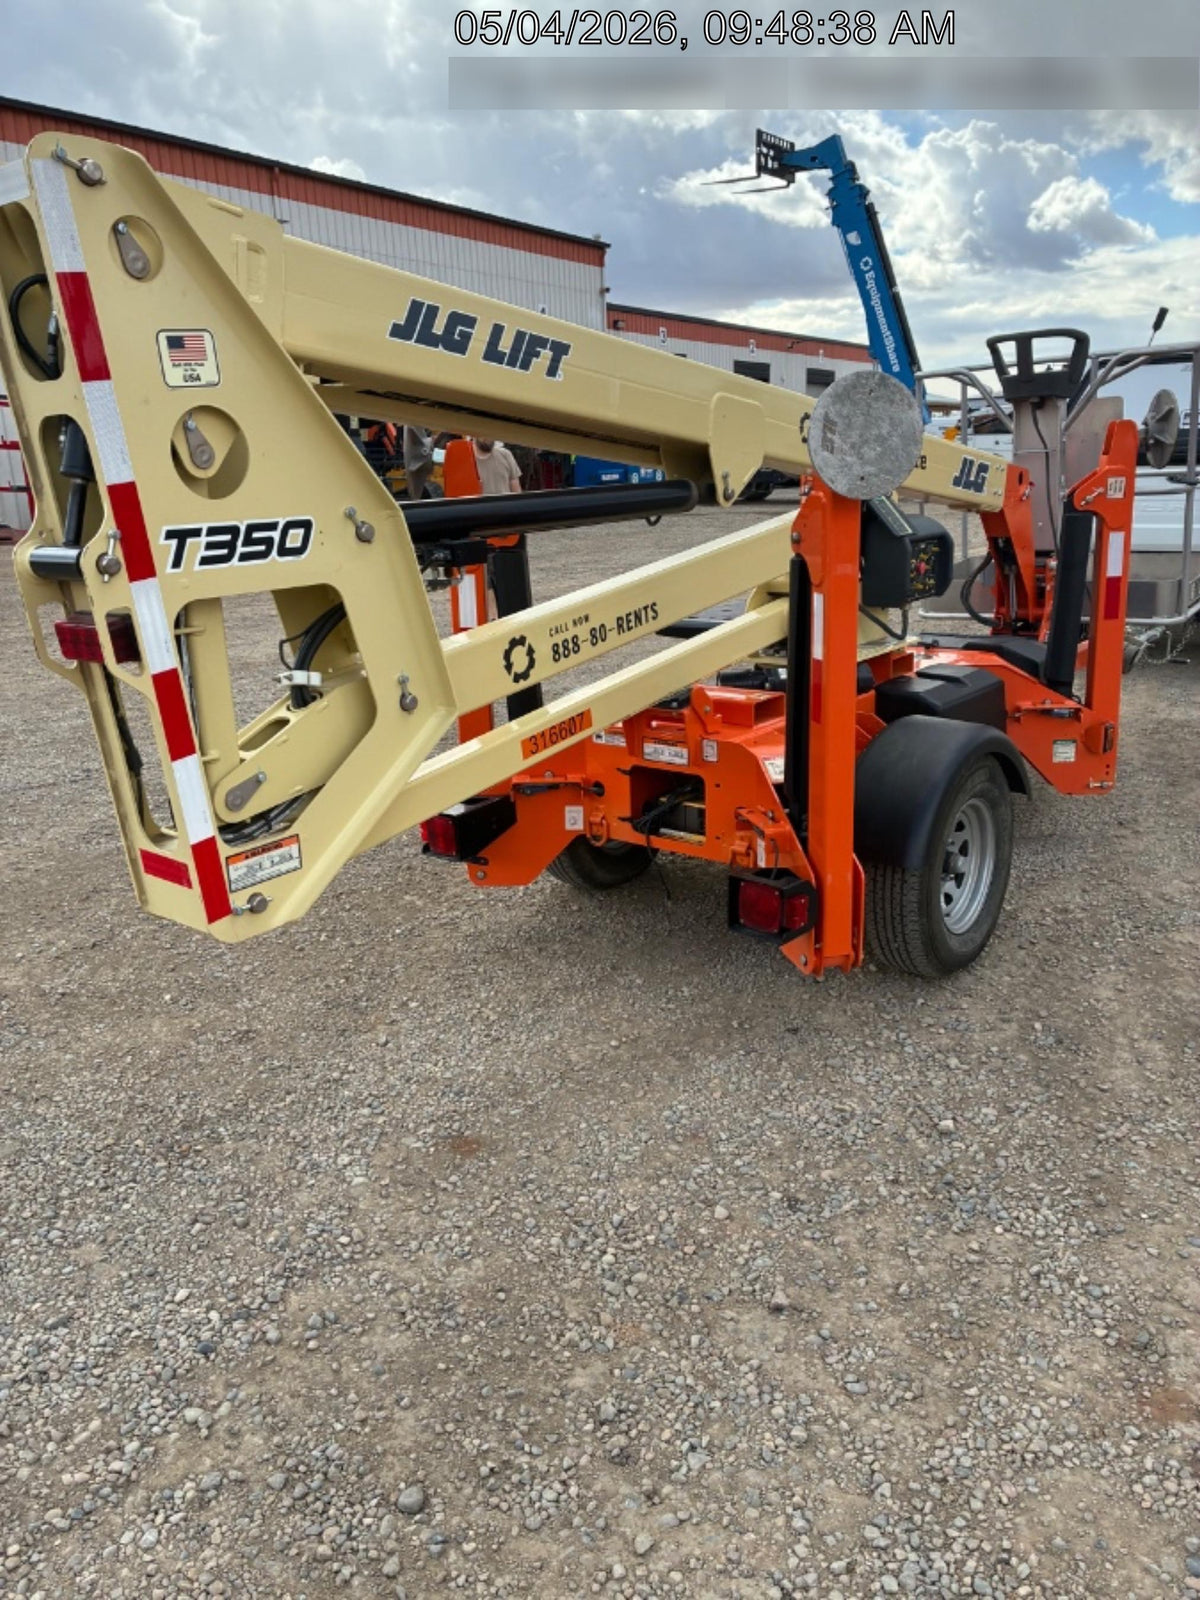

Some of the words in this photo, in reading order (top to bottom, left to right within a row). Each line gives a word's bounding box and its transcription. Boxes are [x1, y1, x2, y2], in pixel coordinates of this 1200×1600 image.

[387, 297, 479, 357] JLG
[481, 322, 572, 380] LIFT
[951, 455, 990, 494] JLG
[161, 516, 315, 572] T350
[549, 623, 569, 638] CALL
[572, 613, 590, 628] NOW
[551, 601, 659, 663] 888-80-RENTS
[528, 711, 584, 755] 316607
